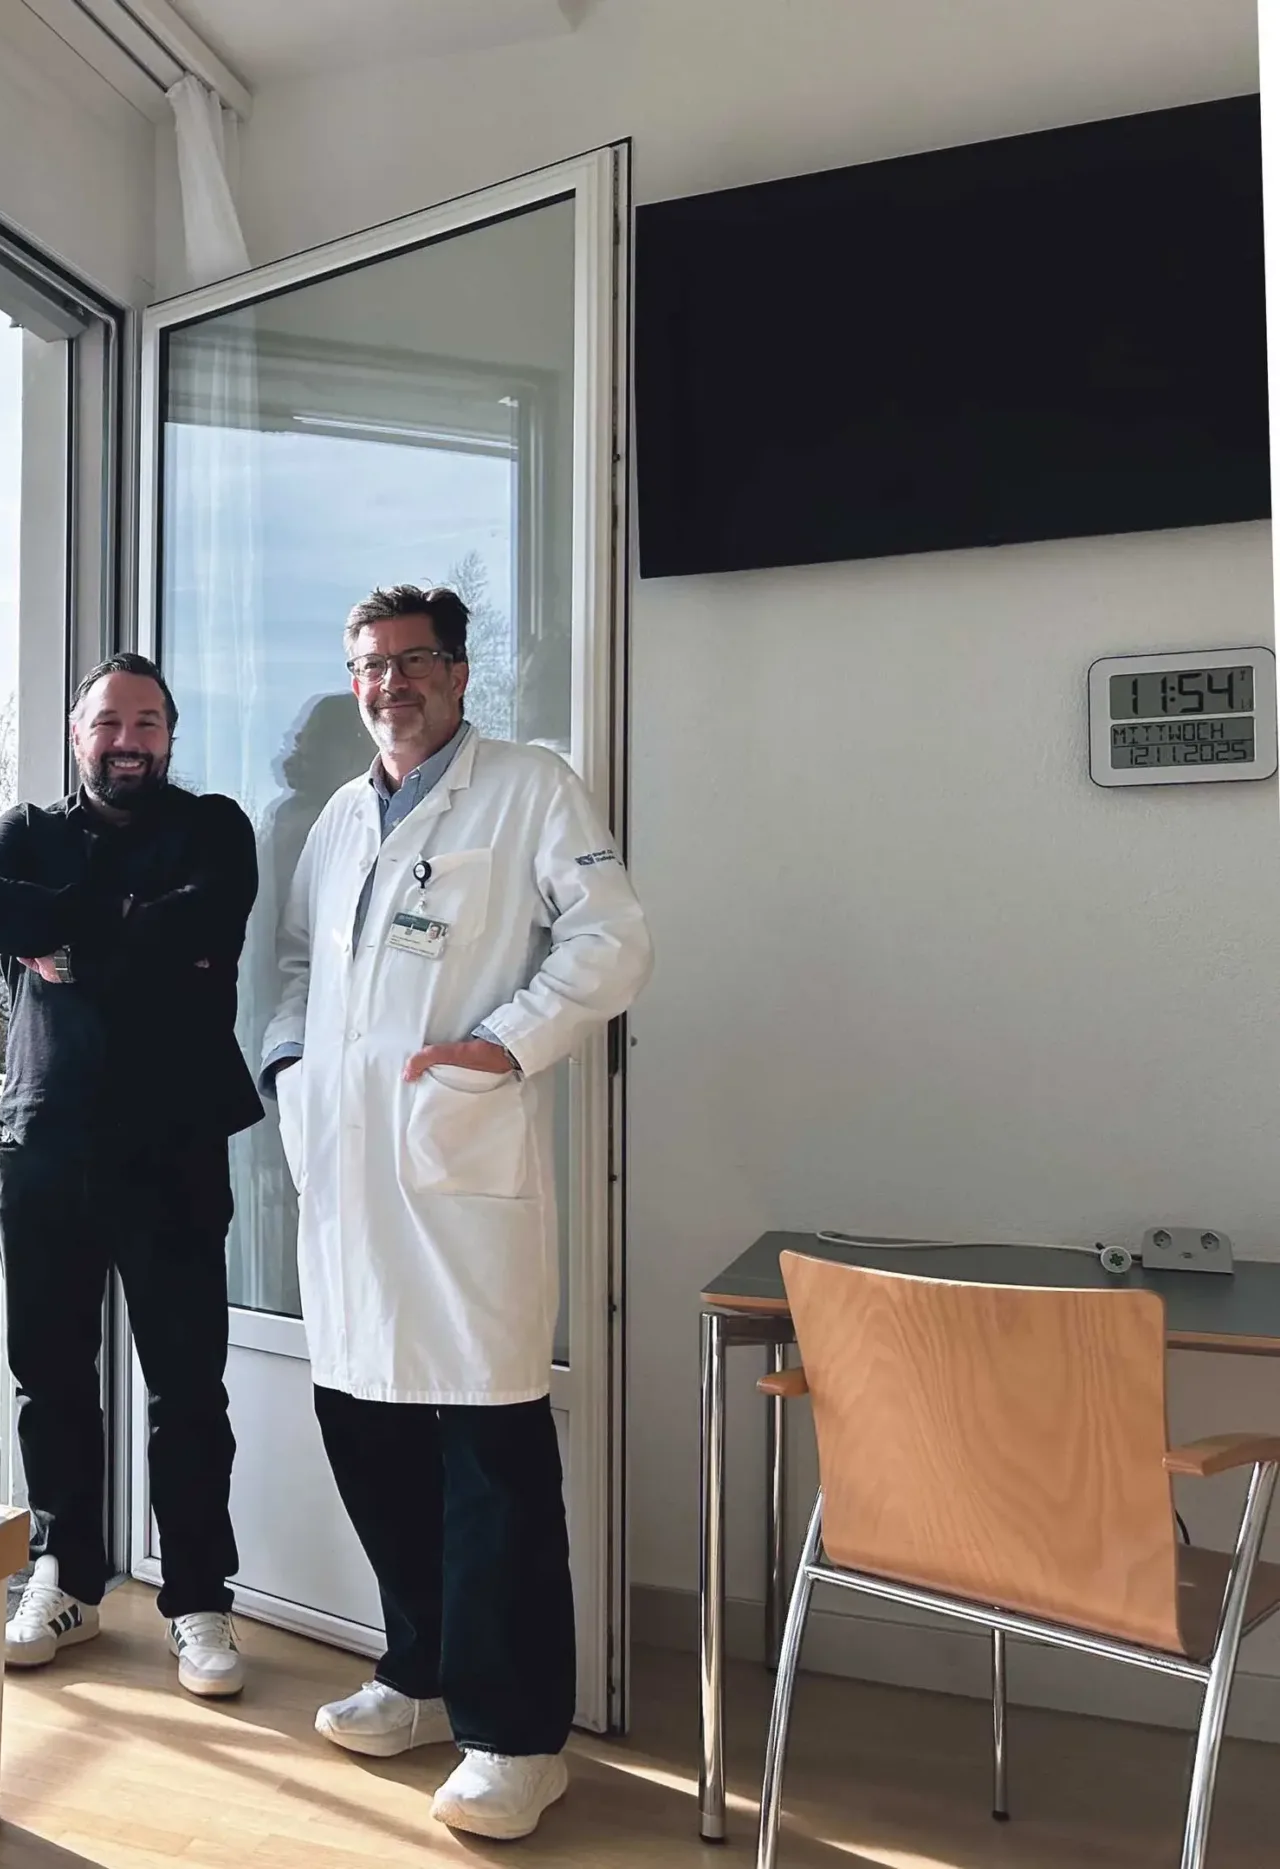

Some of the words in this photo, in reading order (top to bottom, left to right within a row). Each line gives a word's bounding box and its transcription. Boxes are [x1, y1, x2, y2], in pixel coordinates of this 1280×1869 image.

[1132, 673, 1234, 715] 11:54
[1113, 722, 1224, 745] MITTWOCH
[1130, 742, 1247, 765] 12.11.2025
